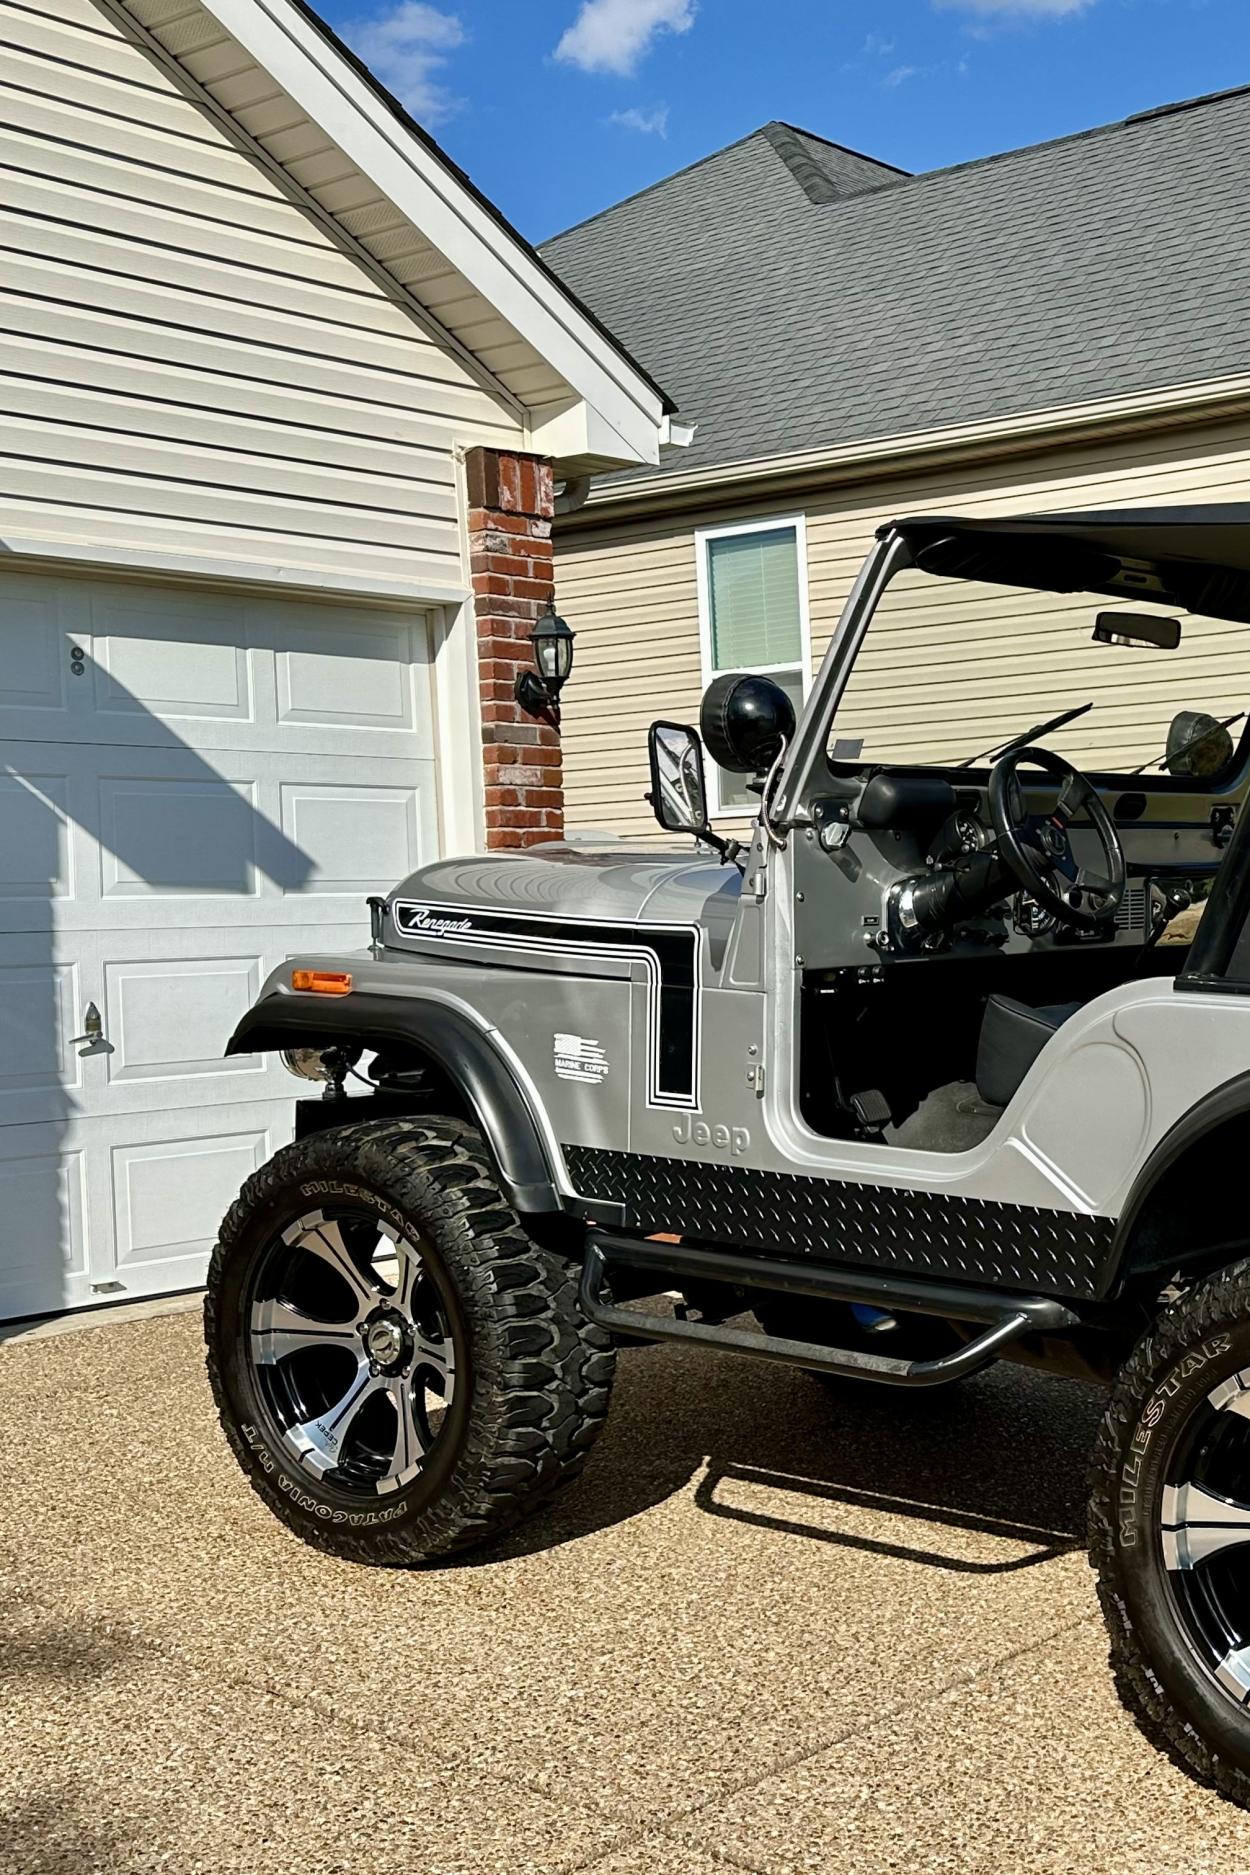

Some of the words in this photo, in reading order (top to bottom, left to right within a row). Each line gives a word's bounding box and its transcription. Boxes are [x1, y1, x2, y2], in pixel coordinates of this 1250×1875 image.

[408, 909, 472, 935] Renegade
[555, 1058, 581, 1070] MARINE
[584, 1063, 609, 1074] CORPS
[672, 1112, 750, 1156] Jeep
[301, 1180, 420, 1242] MILESTAR
[241, 1423, 274, 1473] M/T
[315, 1420, 338, 1446] CEPEK
[1119, 1332, 1232, 1547] MILESTAR
[278, 1474, 408, 1526] PATAGONIA
